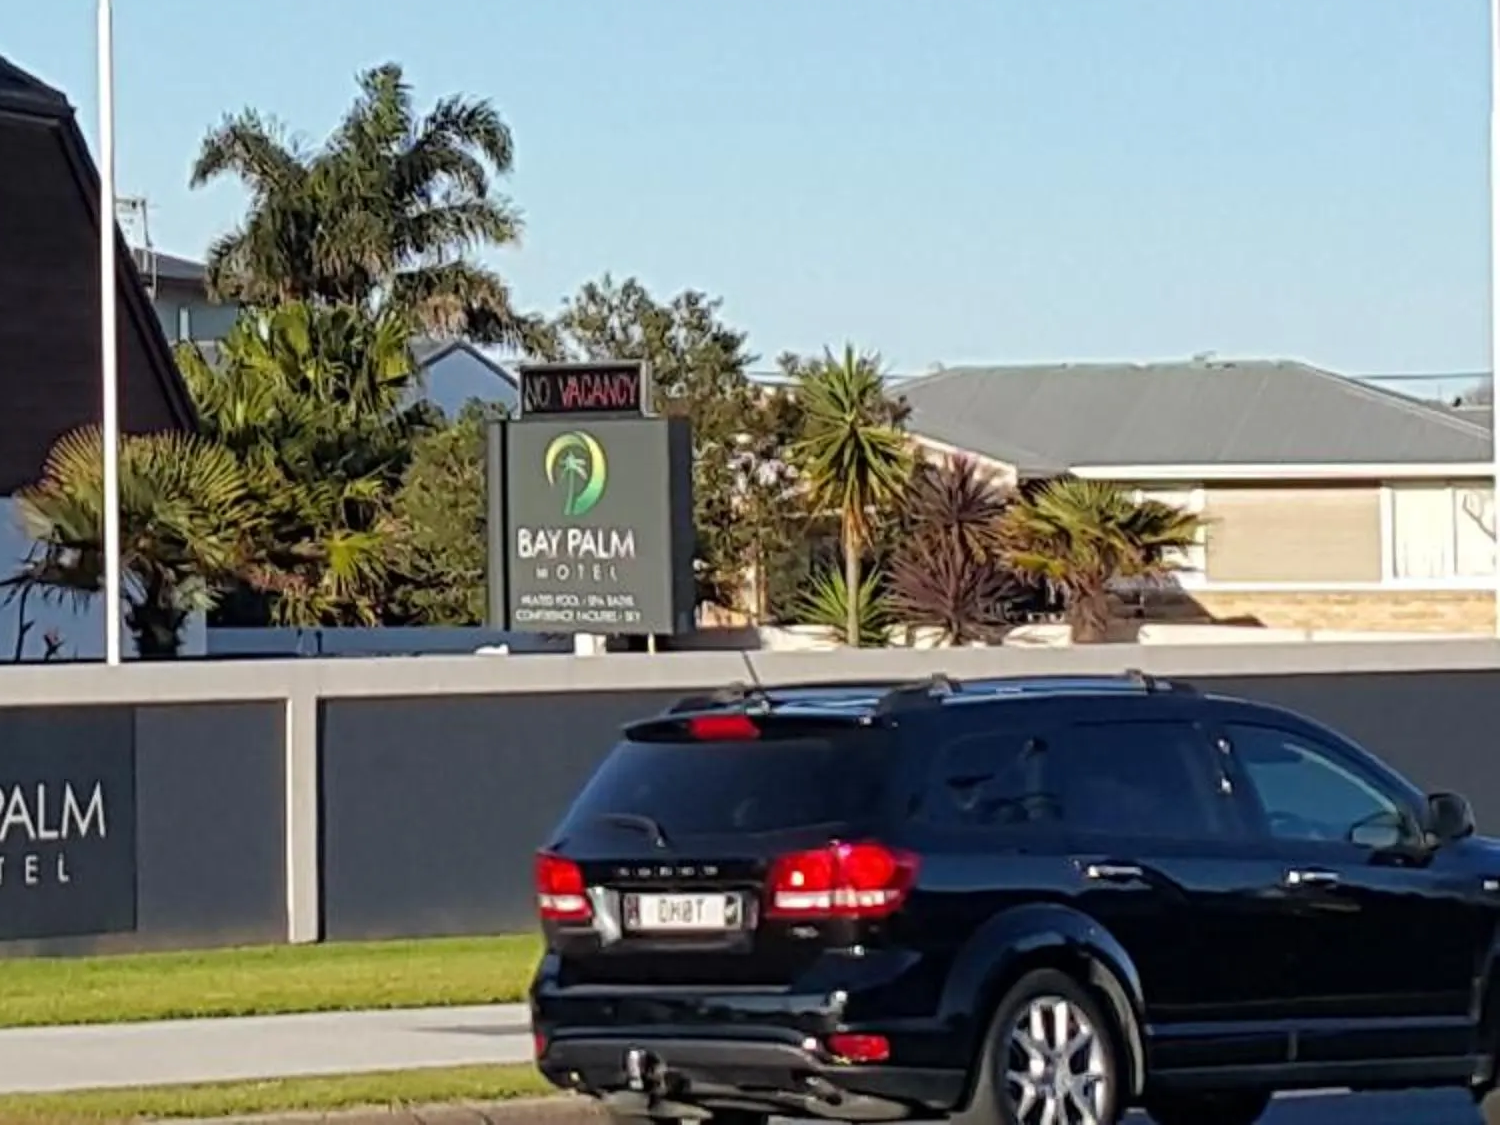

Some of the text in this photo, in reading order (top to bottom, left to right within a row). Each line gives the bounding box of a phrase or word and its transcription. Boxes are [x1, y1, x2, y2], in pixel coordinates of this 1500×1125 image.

[524, 373, 638, 411] NO VACANCY
[516, 527, 636, 559] BAY PALM
[535, 563, 618, 581] MOTEL
